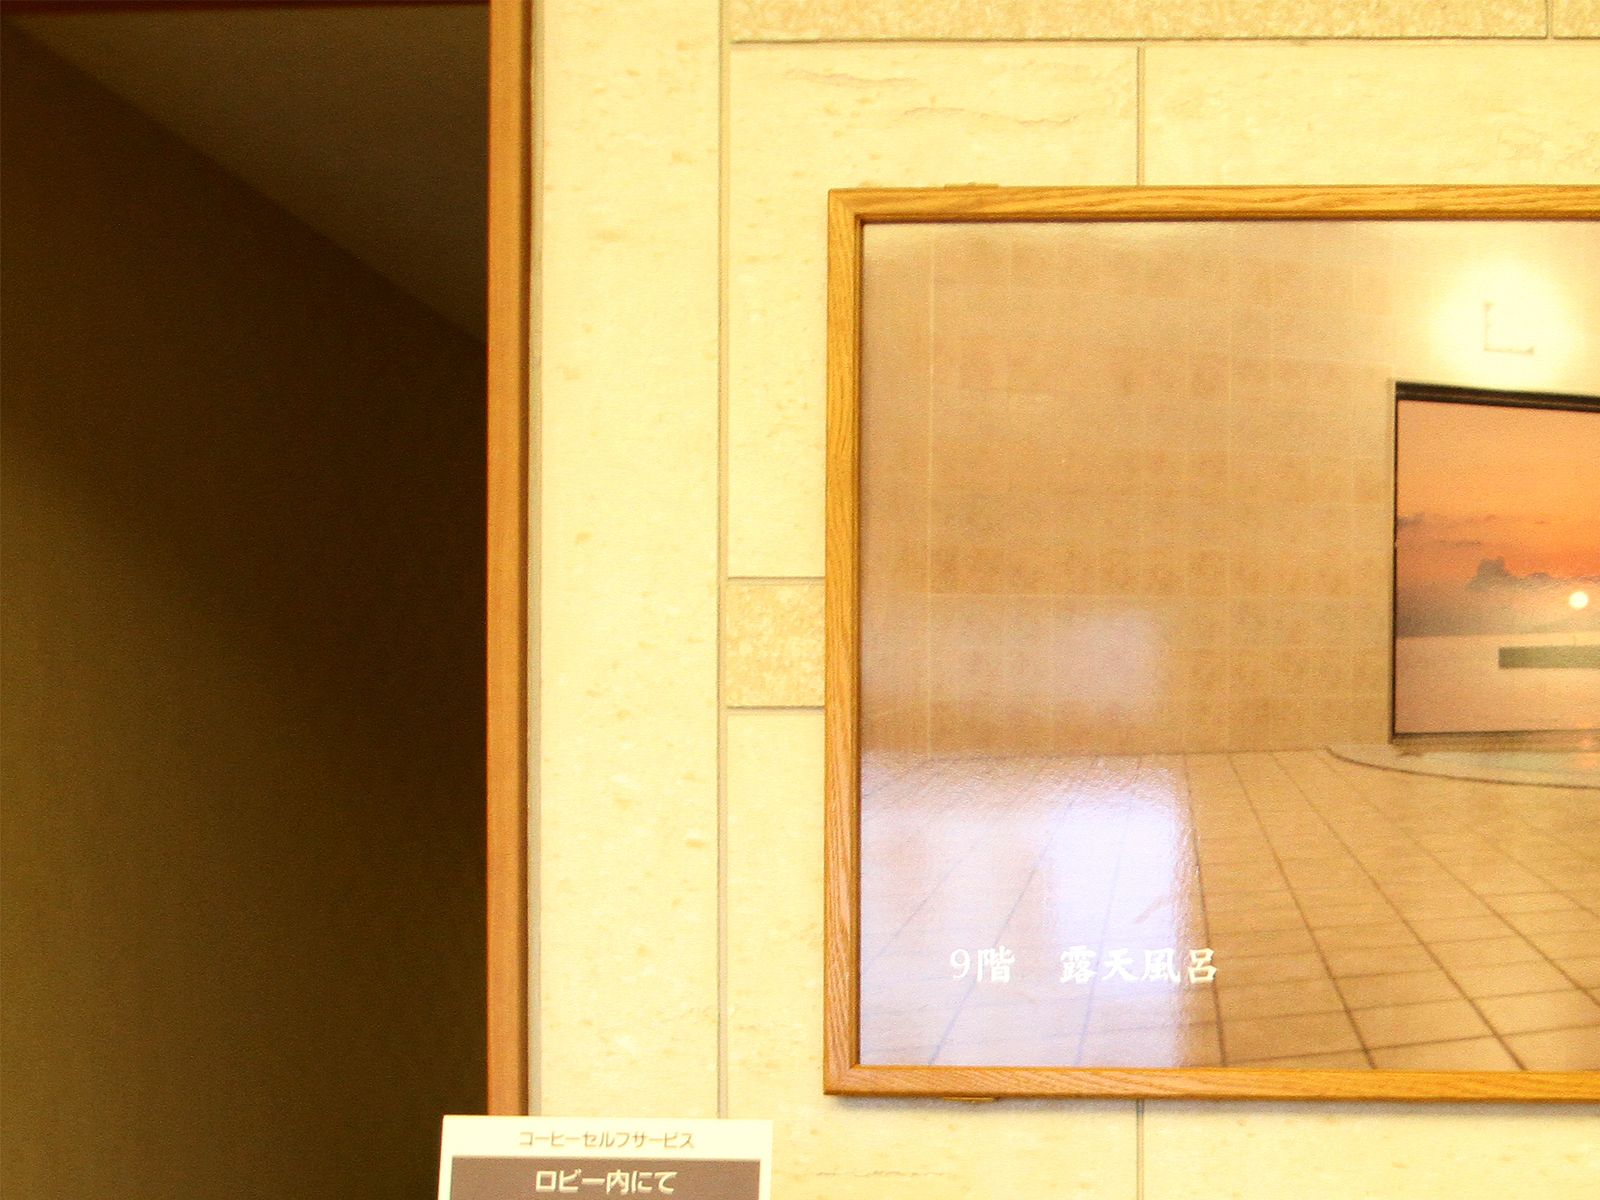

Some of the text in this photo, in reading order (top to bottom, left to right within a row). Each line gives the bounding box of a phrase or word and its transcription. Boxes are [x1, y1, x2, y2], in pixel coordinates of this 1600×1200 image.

[950, 945, 1218, 985] 9階 露天風呂
[519, 1131, 694, 1150] コーヒーセルフサービス
[535, 1169, 678, 1194] ロビー内にて
